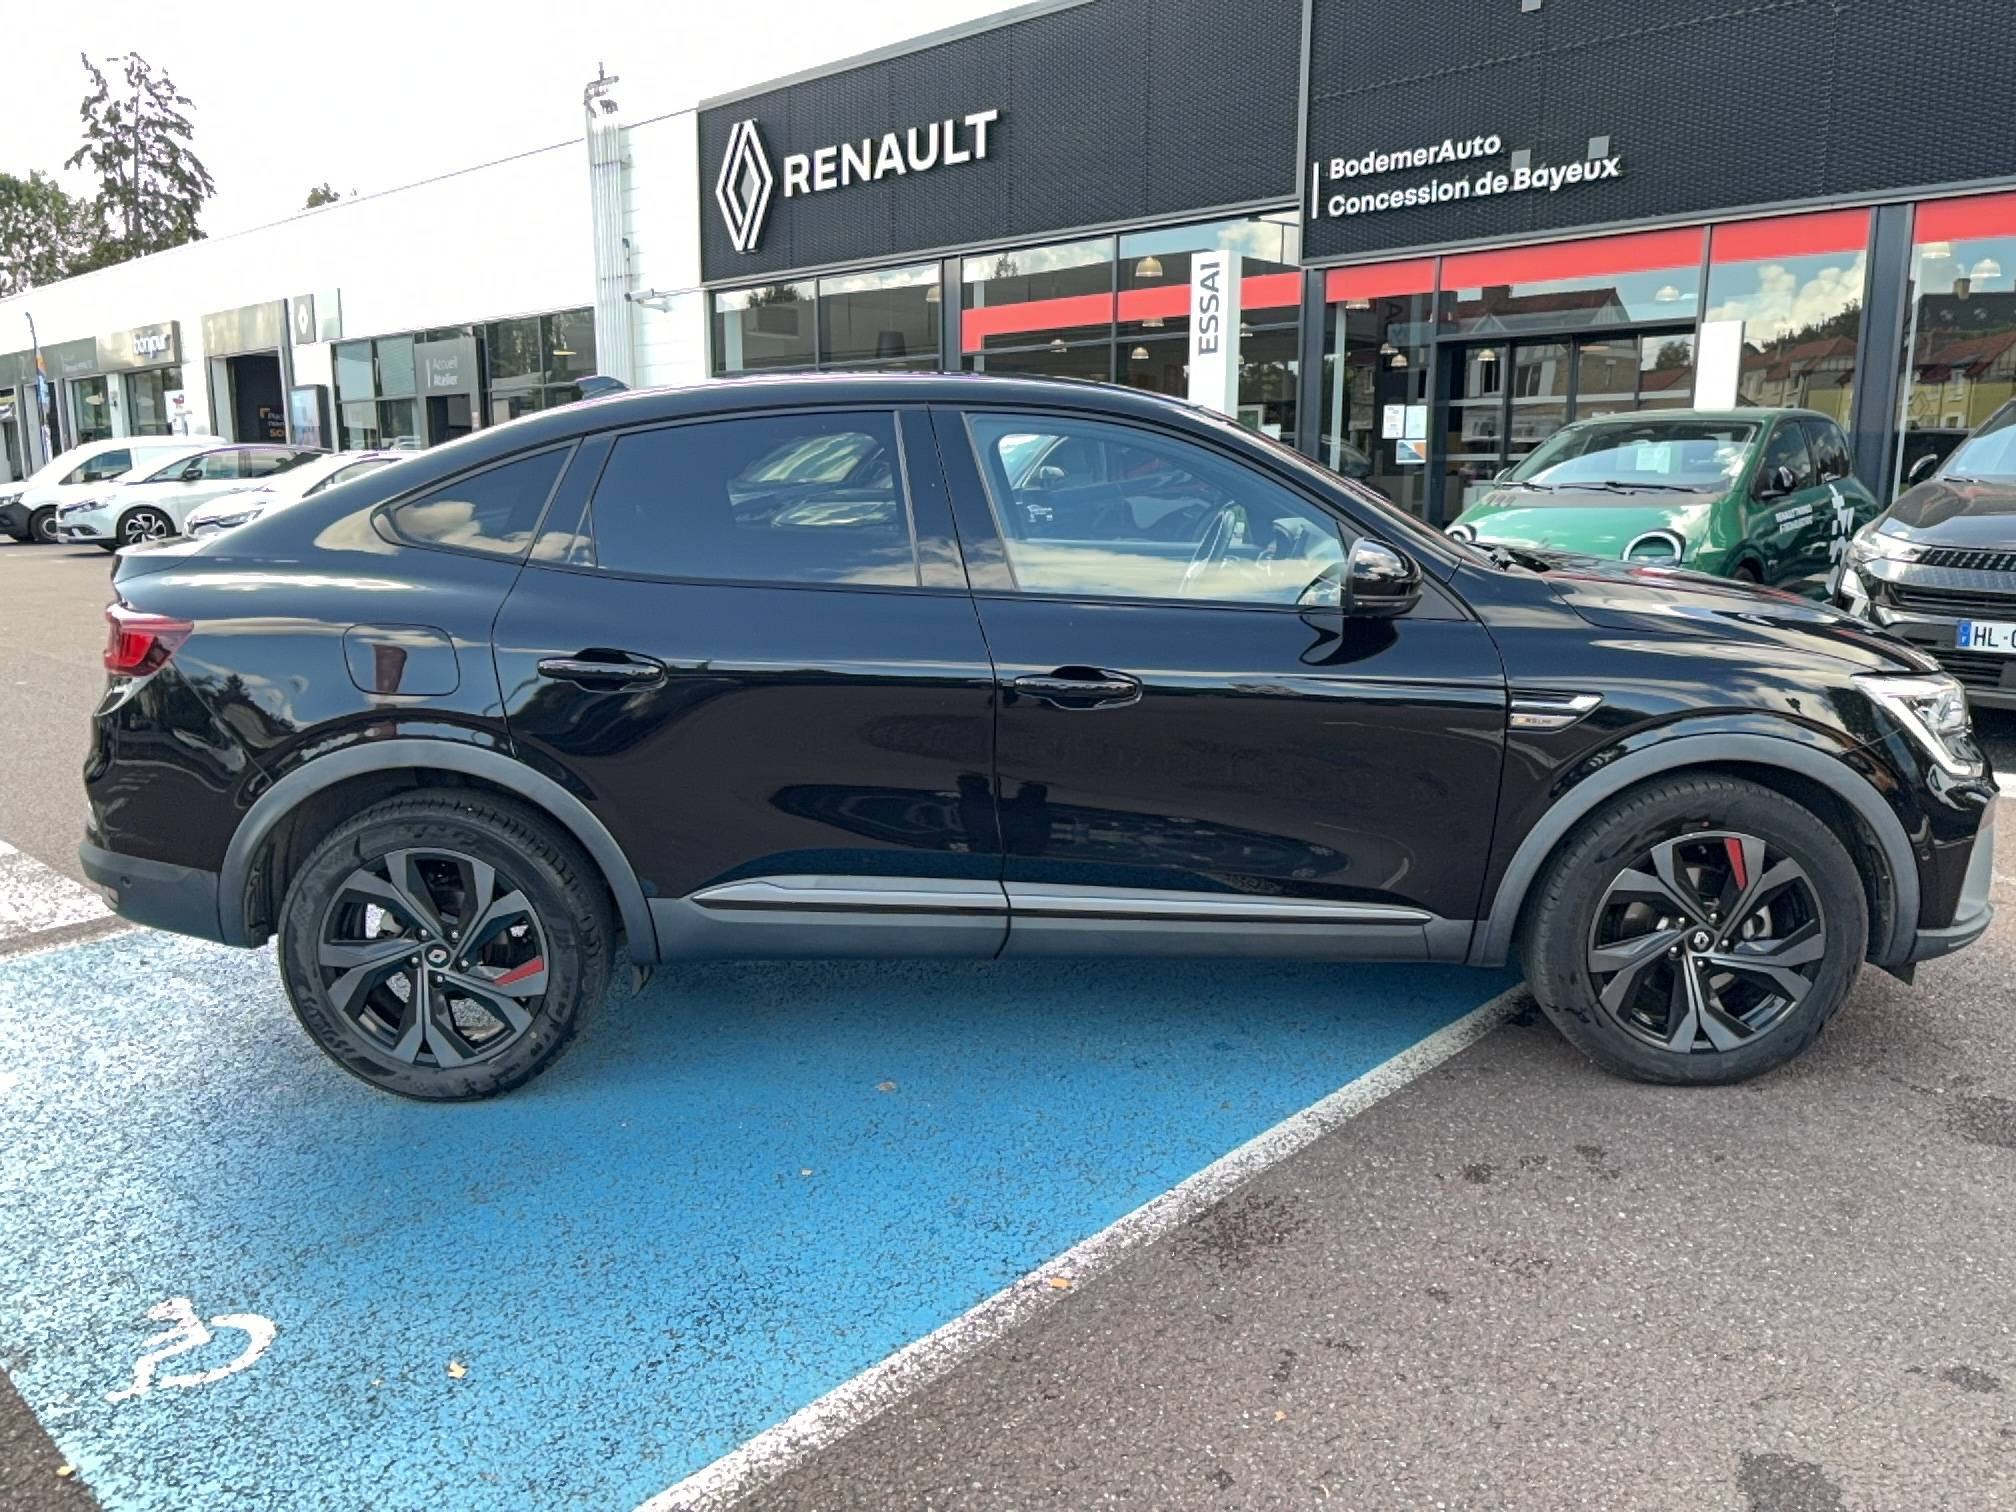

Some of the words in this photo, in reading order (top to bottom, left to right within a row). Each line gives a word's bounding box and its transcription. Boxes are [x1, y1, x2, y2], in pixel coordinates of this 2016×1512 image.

[784, 109, 998, 197] RENAULT
[1327, 181, 1470, 217] Concession
[1475, 172, 1508, 193] de
[1514, 156, 1621, 192] Bayeux
[1329, 135, 1502, 179] BodemerAuto
[1199, 262, 1220, 355] ESSAI
